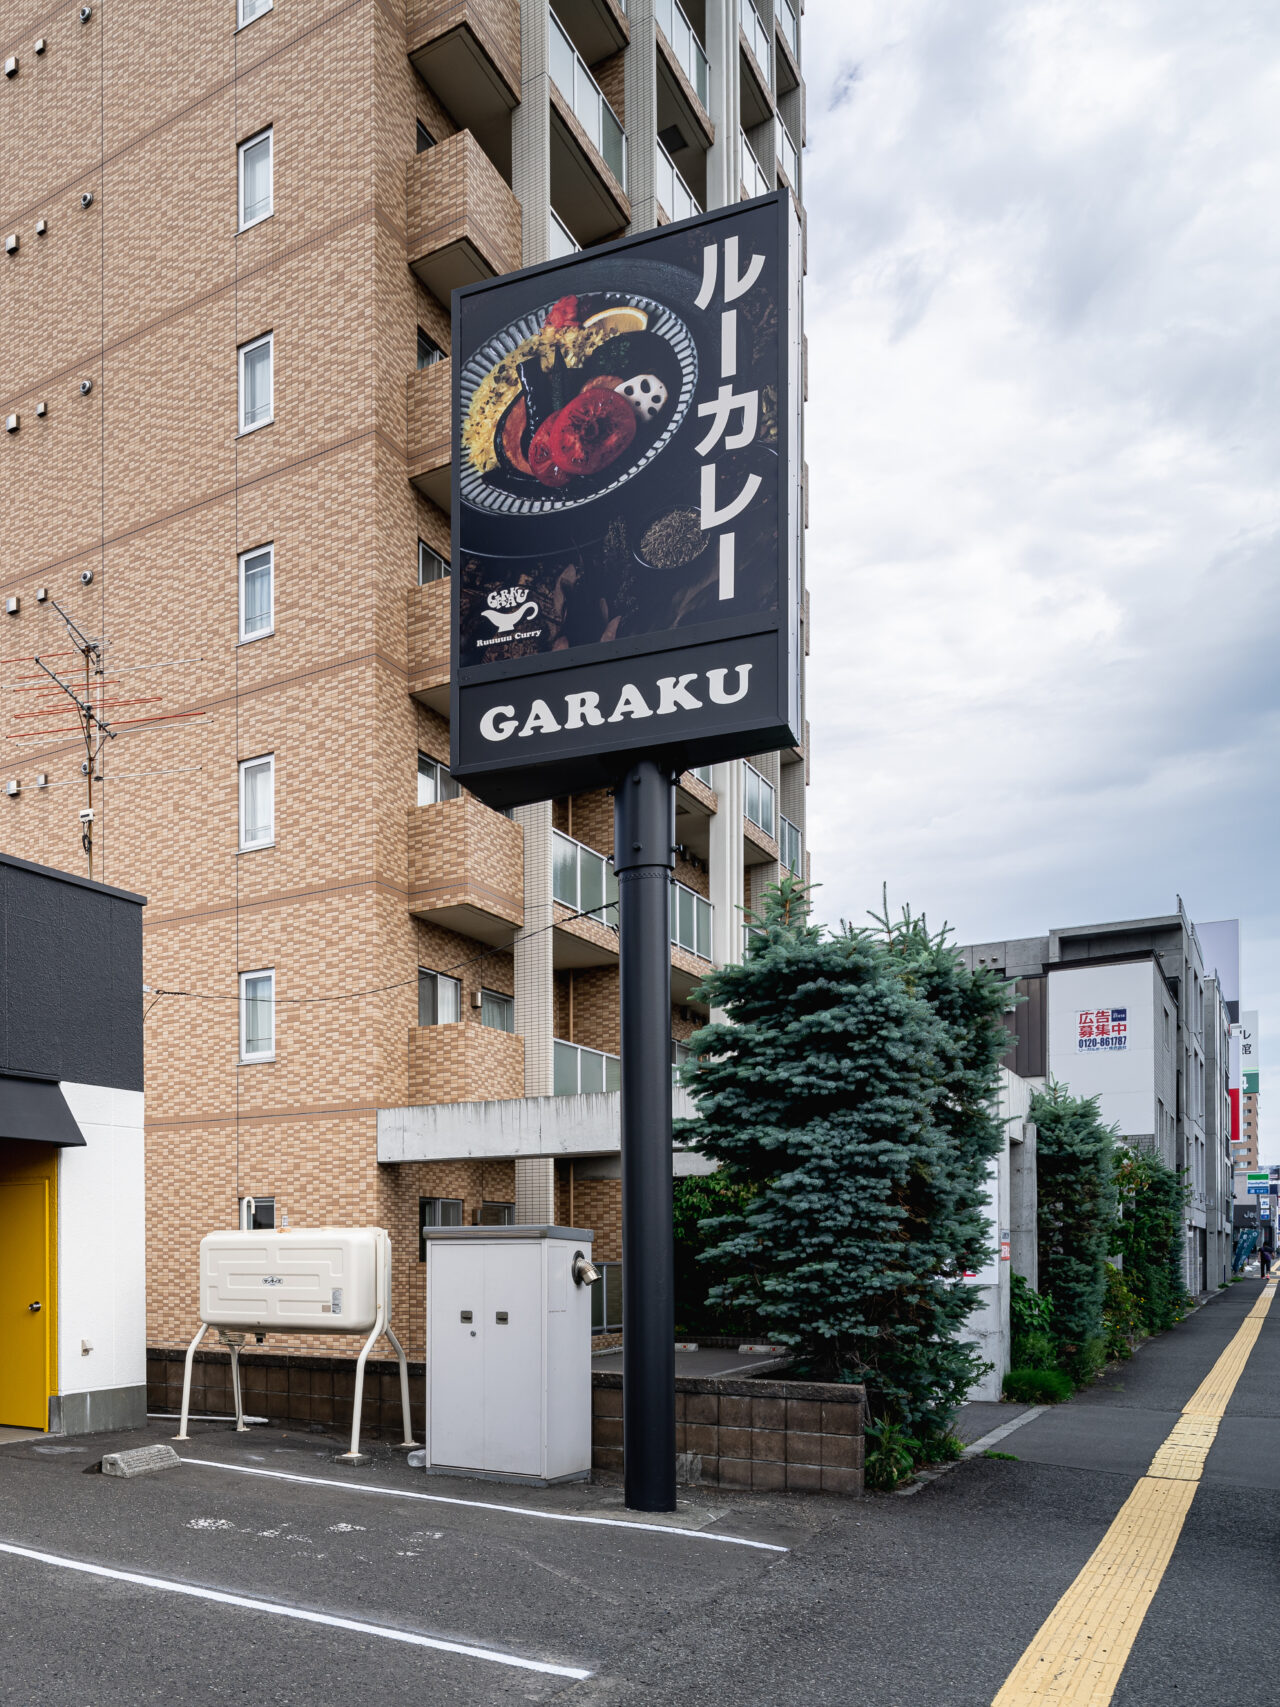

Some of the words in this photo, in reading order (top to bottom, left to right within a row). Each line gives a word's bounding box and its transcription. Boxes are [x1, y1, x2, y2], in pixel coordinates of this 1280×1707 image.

[694, 235, 766, 601] ルーカレー
[514, 629, 542, 640] Curry
[479, 662, 754, 742] GARAKU
[1079, 1010, 1111, 1024] 広告
[1078, 1023, 1127, 1038] 募集中
